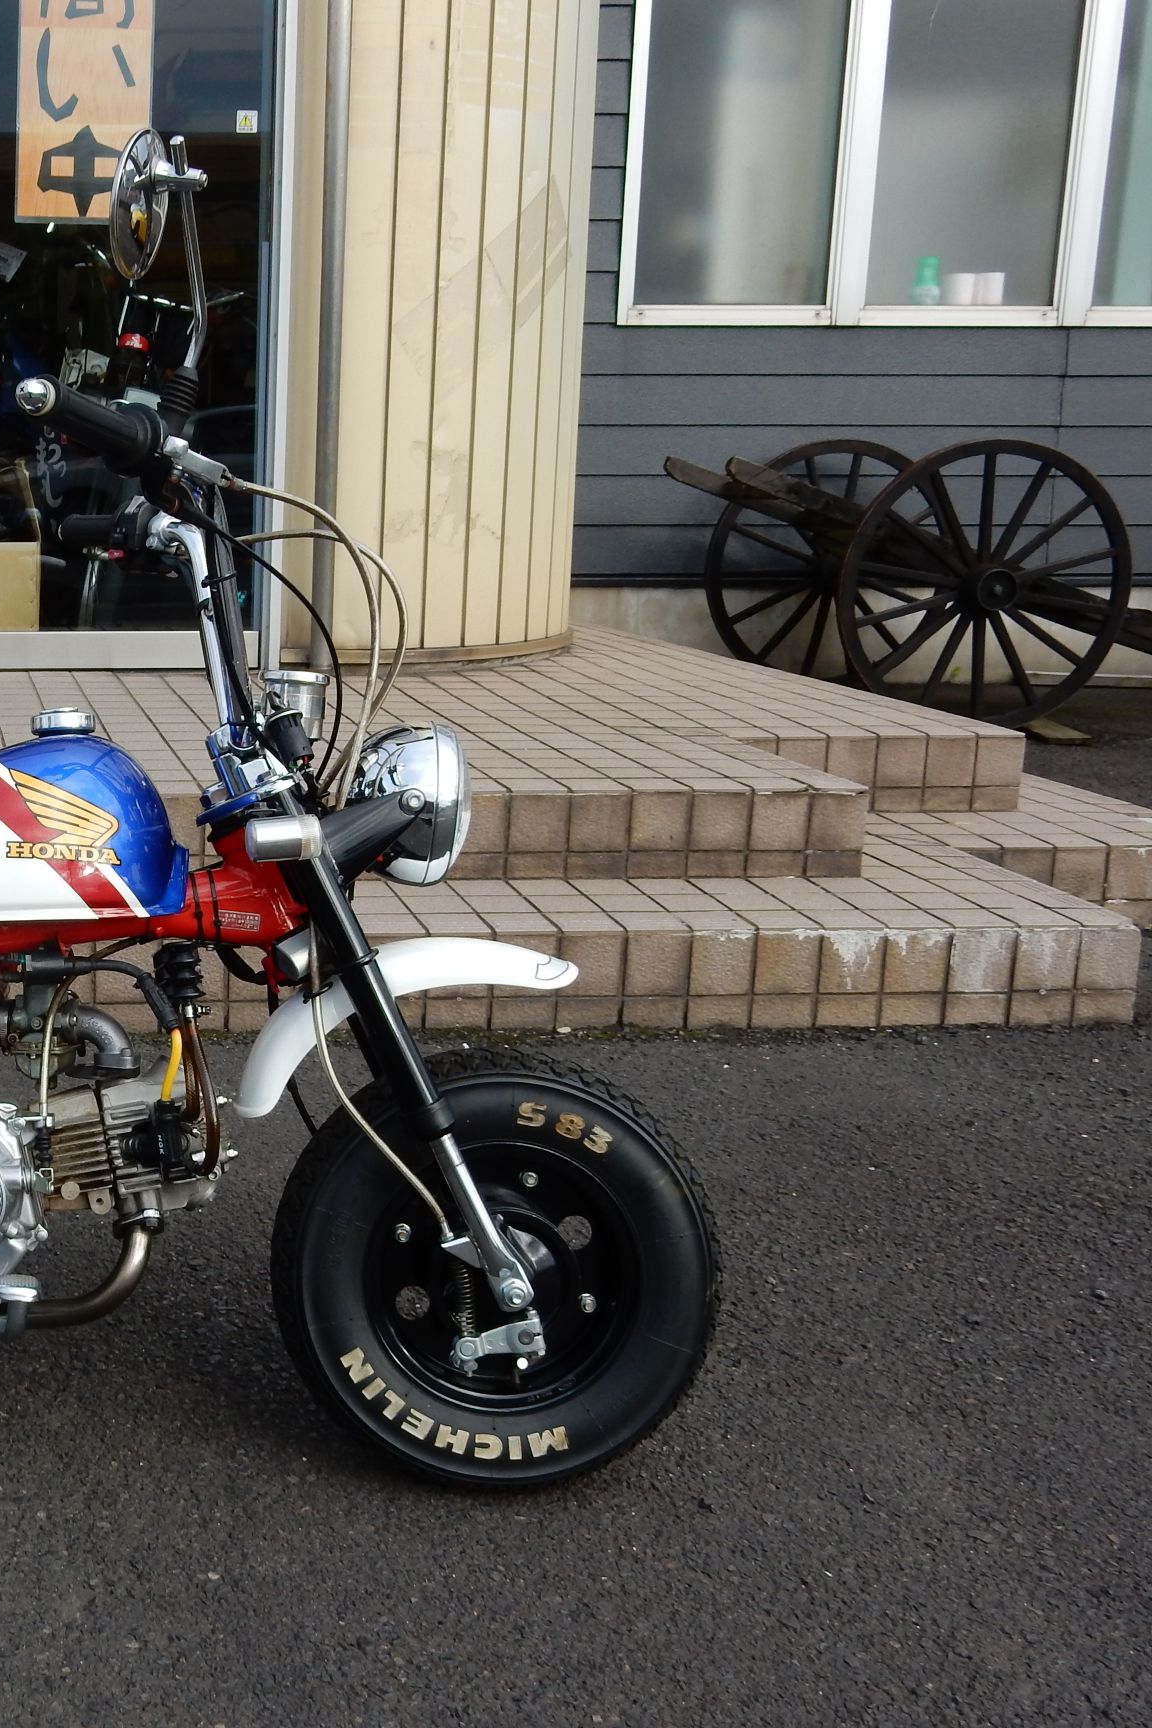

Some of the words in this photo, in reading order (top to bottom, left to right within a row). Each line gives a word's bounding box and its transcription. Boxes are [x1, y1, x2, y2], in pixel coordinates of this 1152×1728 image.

[6, 841, 121, 866] HONDA
[157, 1134, 165, 1155] NGK
[340, 1347, 569, 1460] MICHELIN
